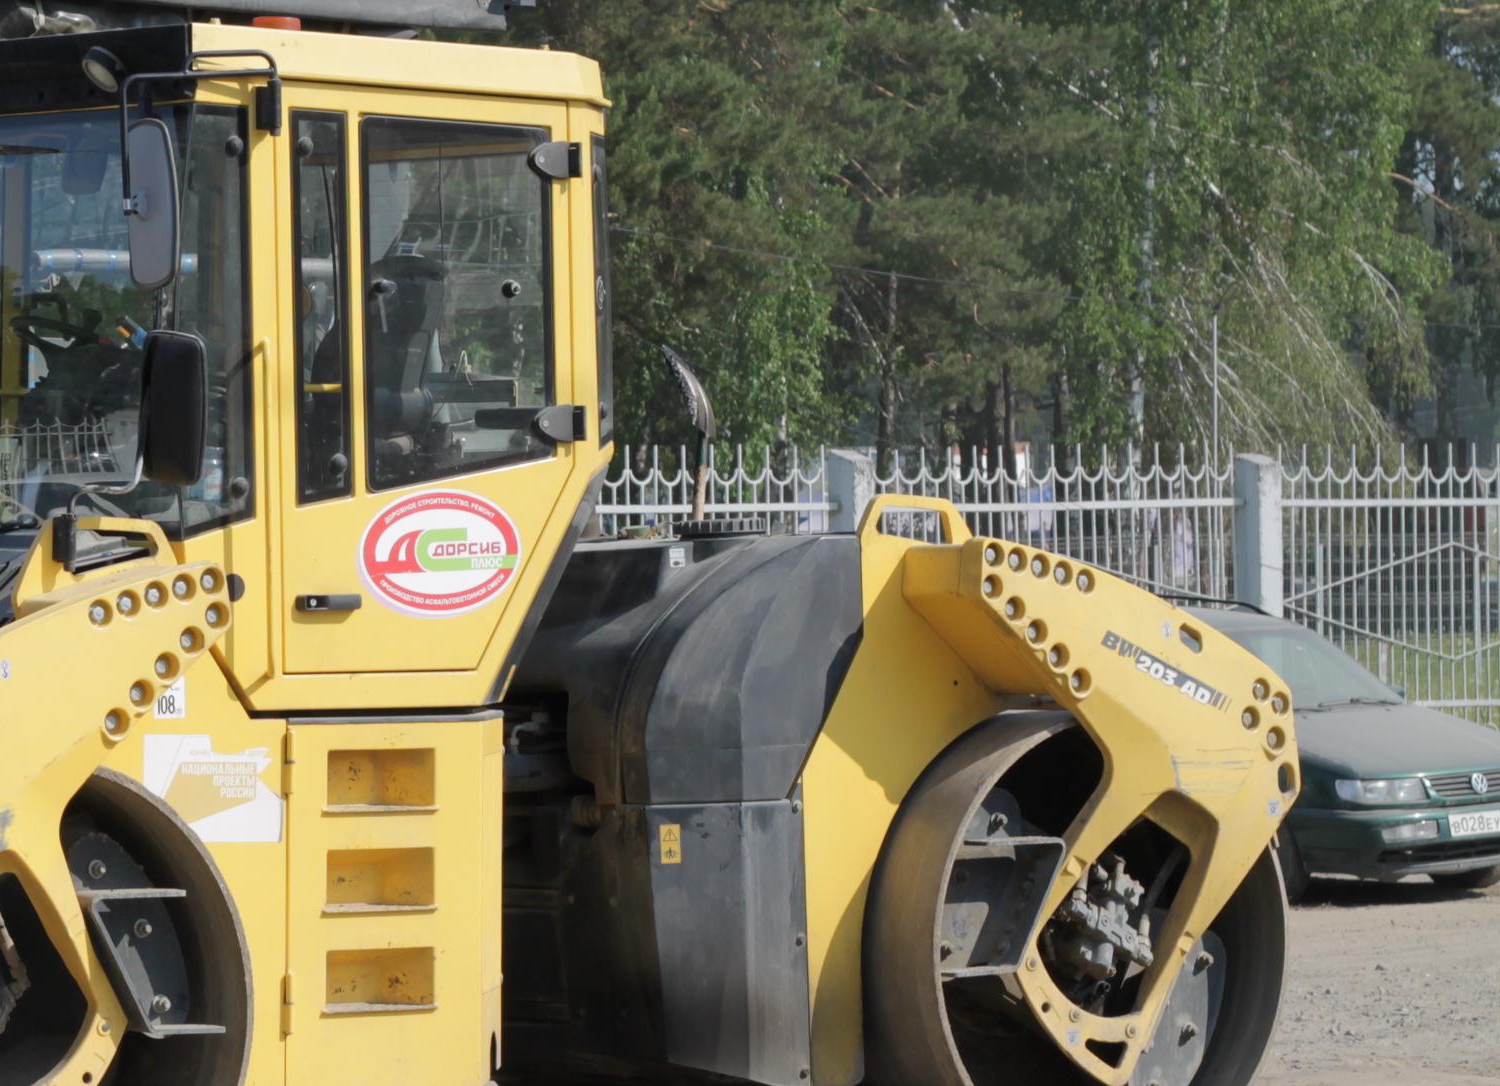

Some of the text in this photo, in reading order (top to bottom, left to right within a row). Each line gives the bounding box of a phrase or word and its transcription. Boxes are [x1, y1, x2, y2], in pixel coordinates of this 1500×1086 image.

[385, 501, 417, 524] ДОРОЖНОЕ
[471, 503, 495, 518] РЕМОНТ
[432, 541, 501, 557] ДОРСИБ
[471, 557, 503, 569] ПЛЮС
[1136, 655, 1178, 686] 203
[1180, 680, 1211, 704] AD
[157, 695, 176, 715] 108
[181, 762, 256, 775] НАЦИОНАЛЬНЫЕ
[212, 775, 256, 787] ПРОЕКТЫ
[220, 787, 256, 799] РОССИИ
